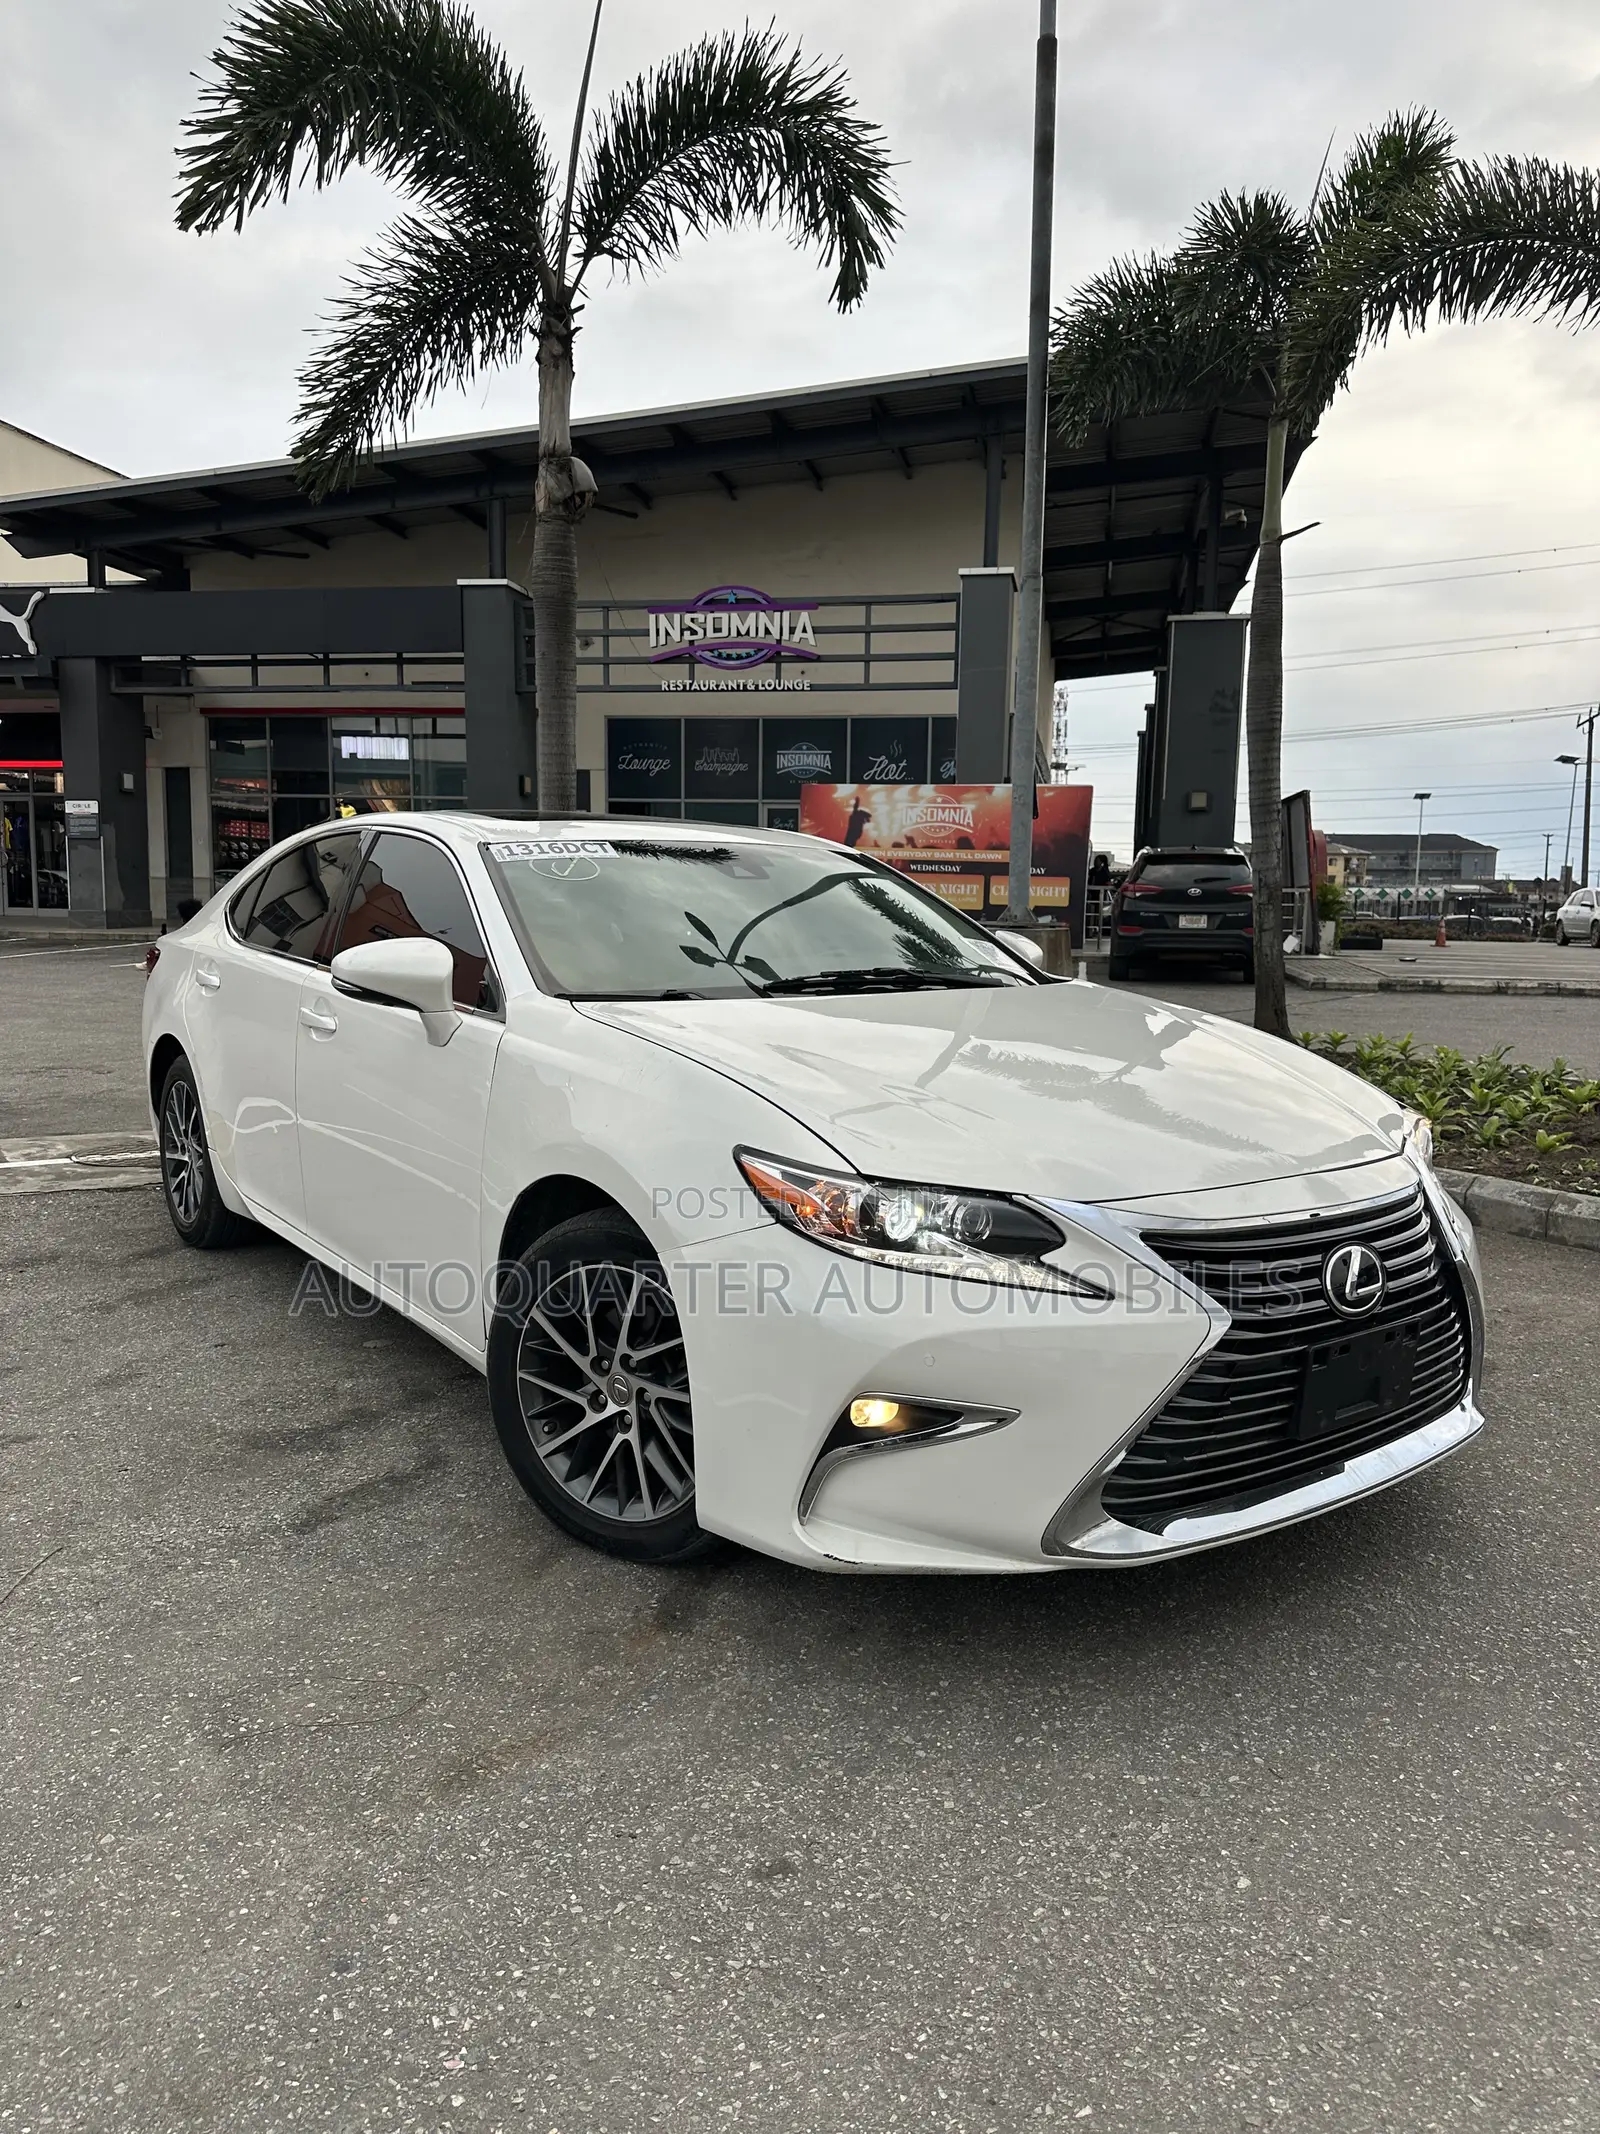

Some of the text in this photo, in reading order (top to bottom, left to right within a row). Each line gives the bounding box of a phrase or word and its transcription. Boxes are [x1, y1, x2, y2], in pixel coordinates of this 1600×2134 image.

[649, 611, 817, 648] INSOMNIA
[661, 679, 745, 691] RESTAURANT
[758, 678, 811, 691] LOUNGE
[617, 753, 672, 777] Lounge
[694, 759, 749, 776] Champagne
[776, 753, 832, 770] INSOMNIA
[901, 807, 974, 828] INSOMNIA
[501, 842, 610, 857] 1316DCT
[887, 850, 933, 859] EVERYDAY
[955, 852, 974, 860] TILL
[974, 852, 1002, 861] DAWN
[909, 863, 962, 873] WEDNESDAY
[939, 883, 980, 895] NIGHT
